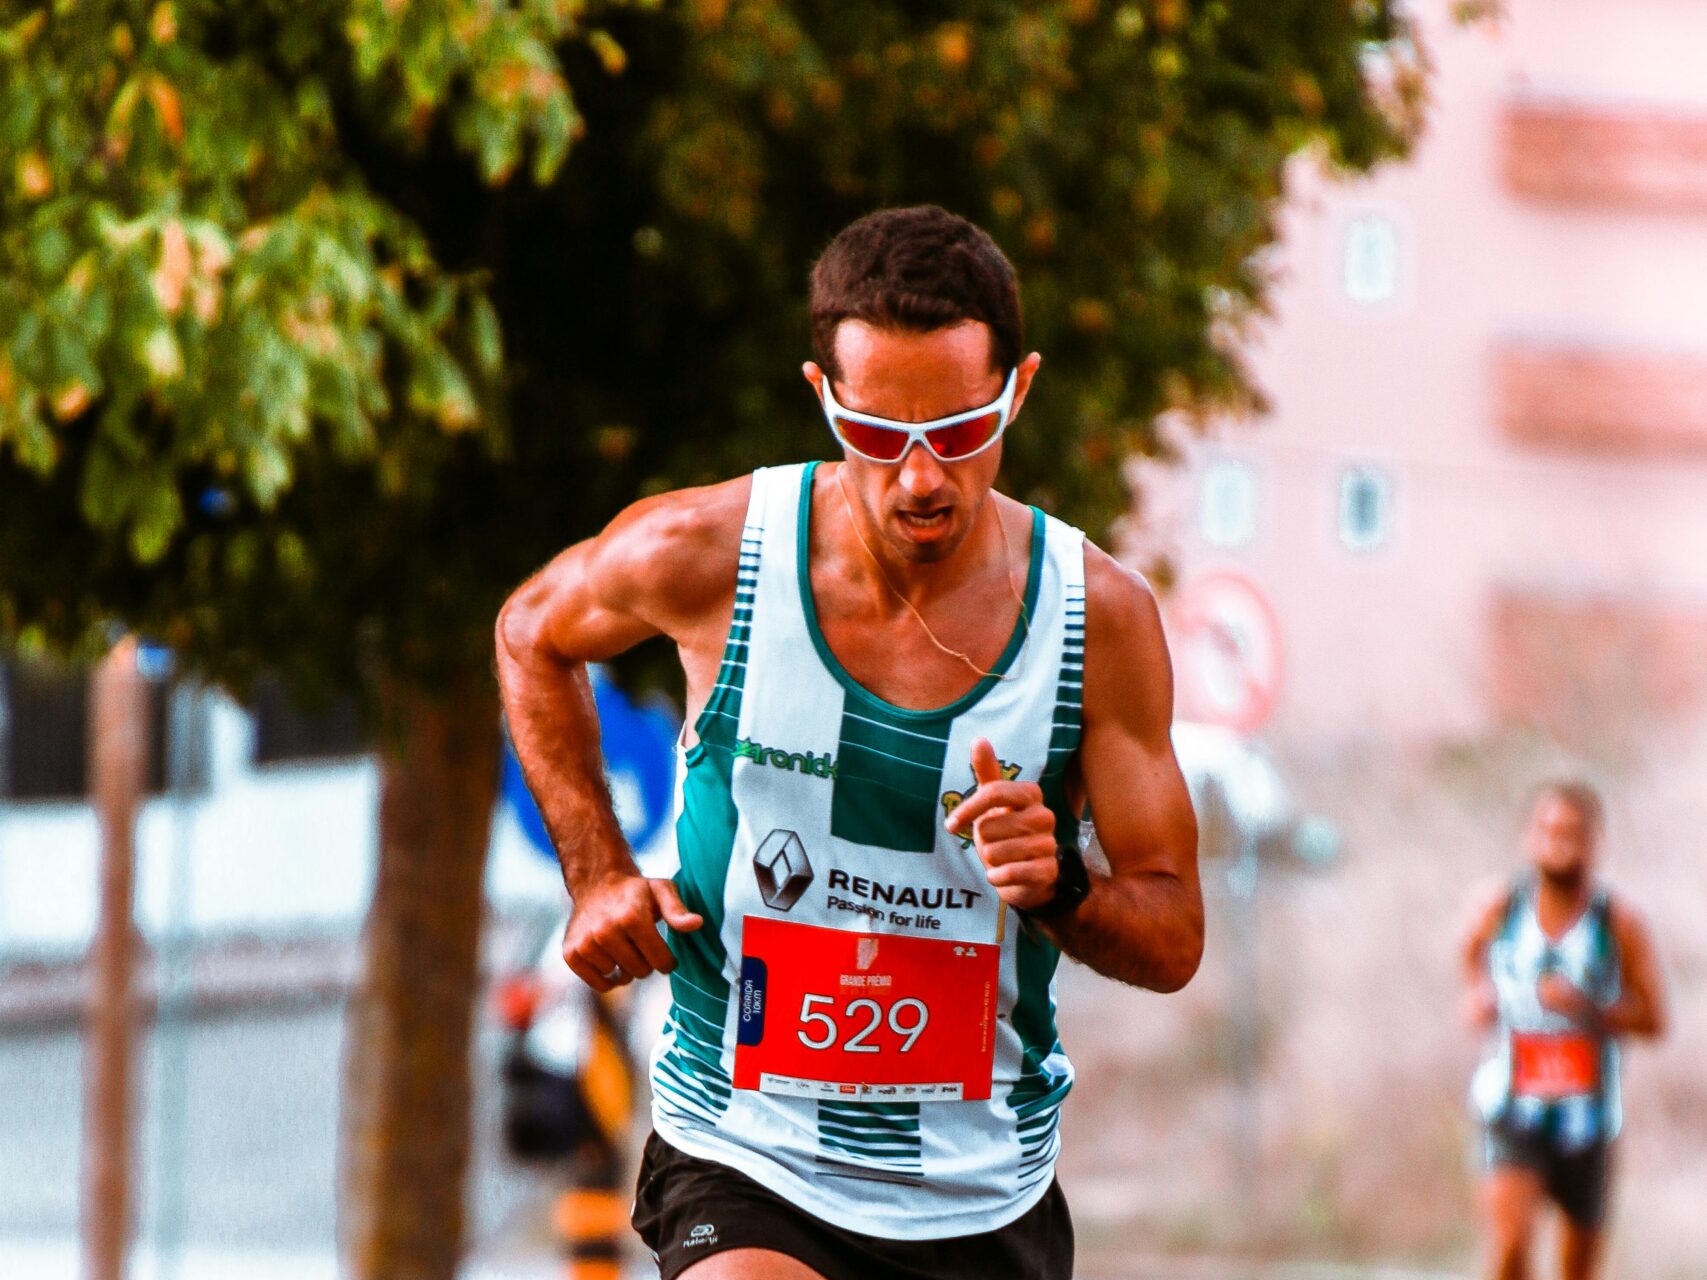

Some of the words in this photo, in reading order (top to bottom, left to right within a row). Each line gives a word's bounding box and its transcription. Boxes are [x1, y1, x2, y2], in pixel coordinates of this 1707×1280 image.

[828, 868, 982, 909] RENAULT
[827, 896, 885, 921] Passion
[889, 911, 913, 927] for
[915, 914, 941, 930] life
[743, 979, 753, 1022] CORRIDA
[797, 993, 929, 1053] 529
